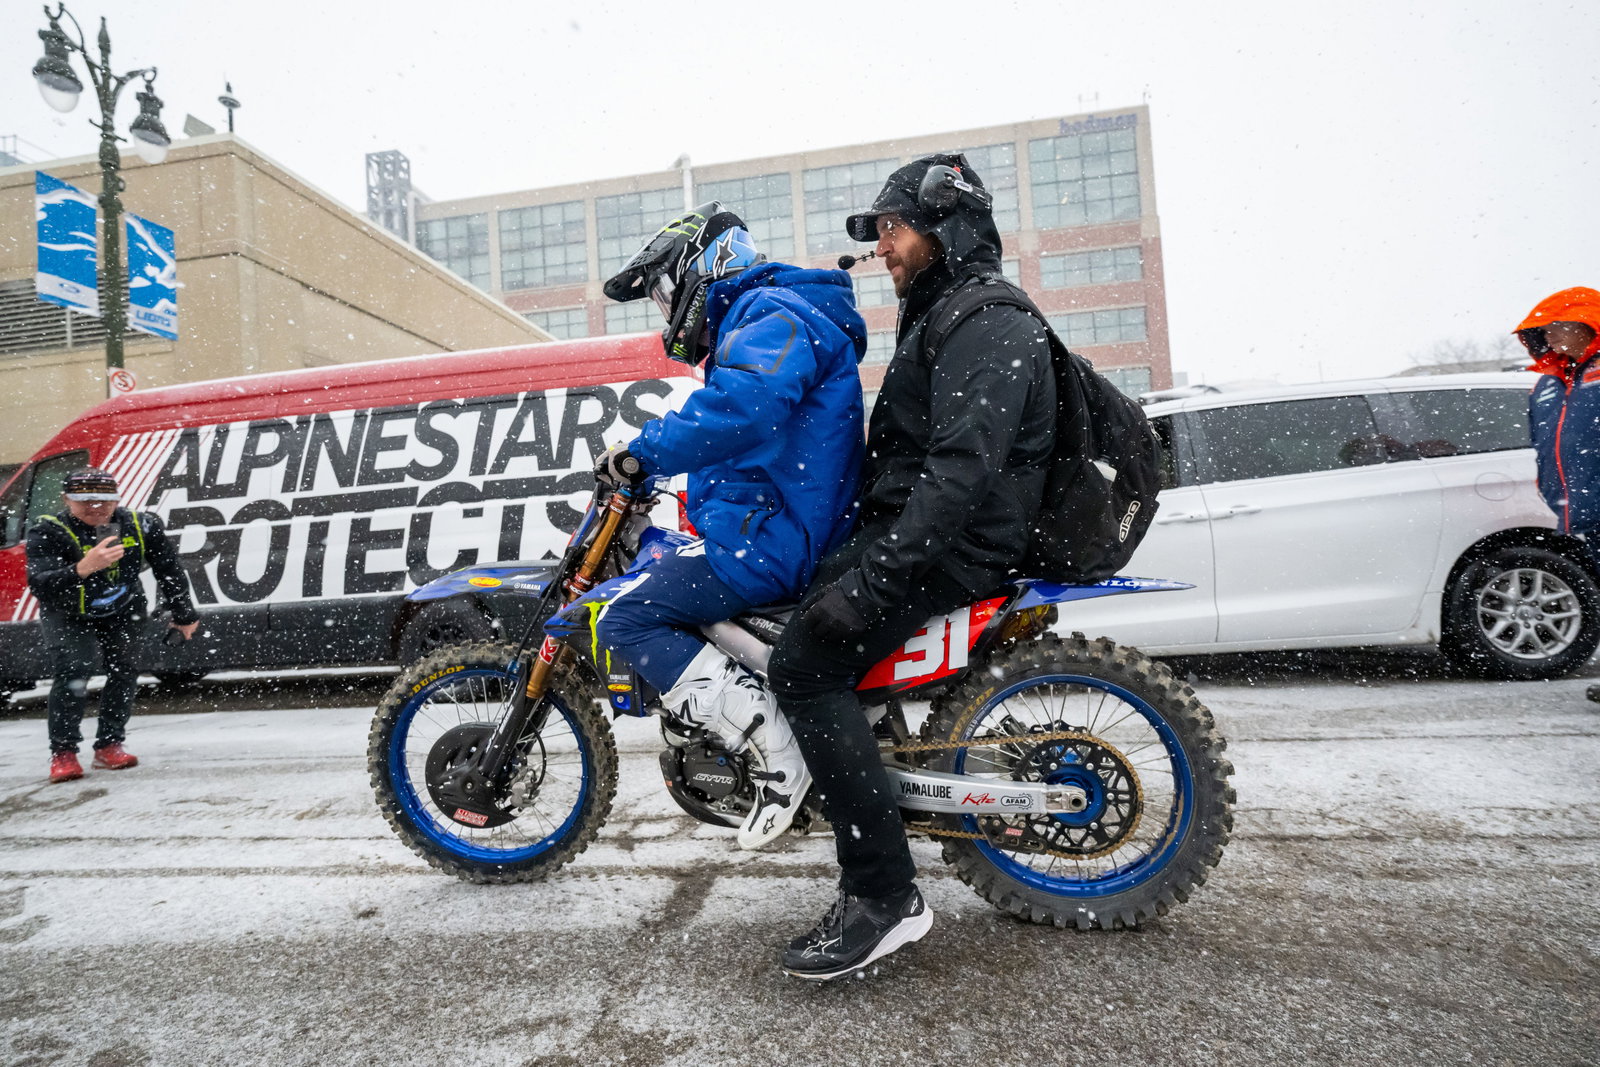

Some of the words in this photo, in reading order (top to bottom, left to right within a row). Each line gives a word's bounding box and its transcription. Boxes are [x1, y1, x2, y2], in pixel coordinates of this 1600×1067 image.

[145, 379, 674, 507] ALPINESTARS
[155, 472, 598, 605] ROTECTS
[520, 583, 541, 591] YAMAHA
[894, 606, 971, 680] 31
[412, 665, 465, 693] DUNLOP
[900, 781, 952, 799] YAMALUBE
